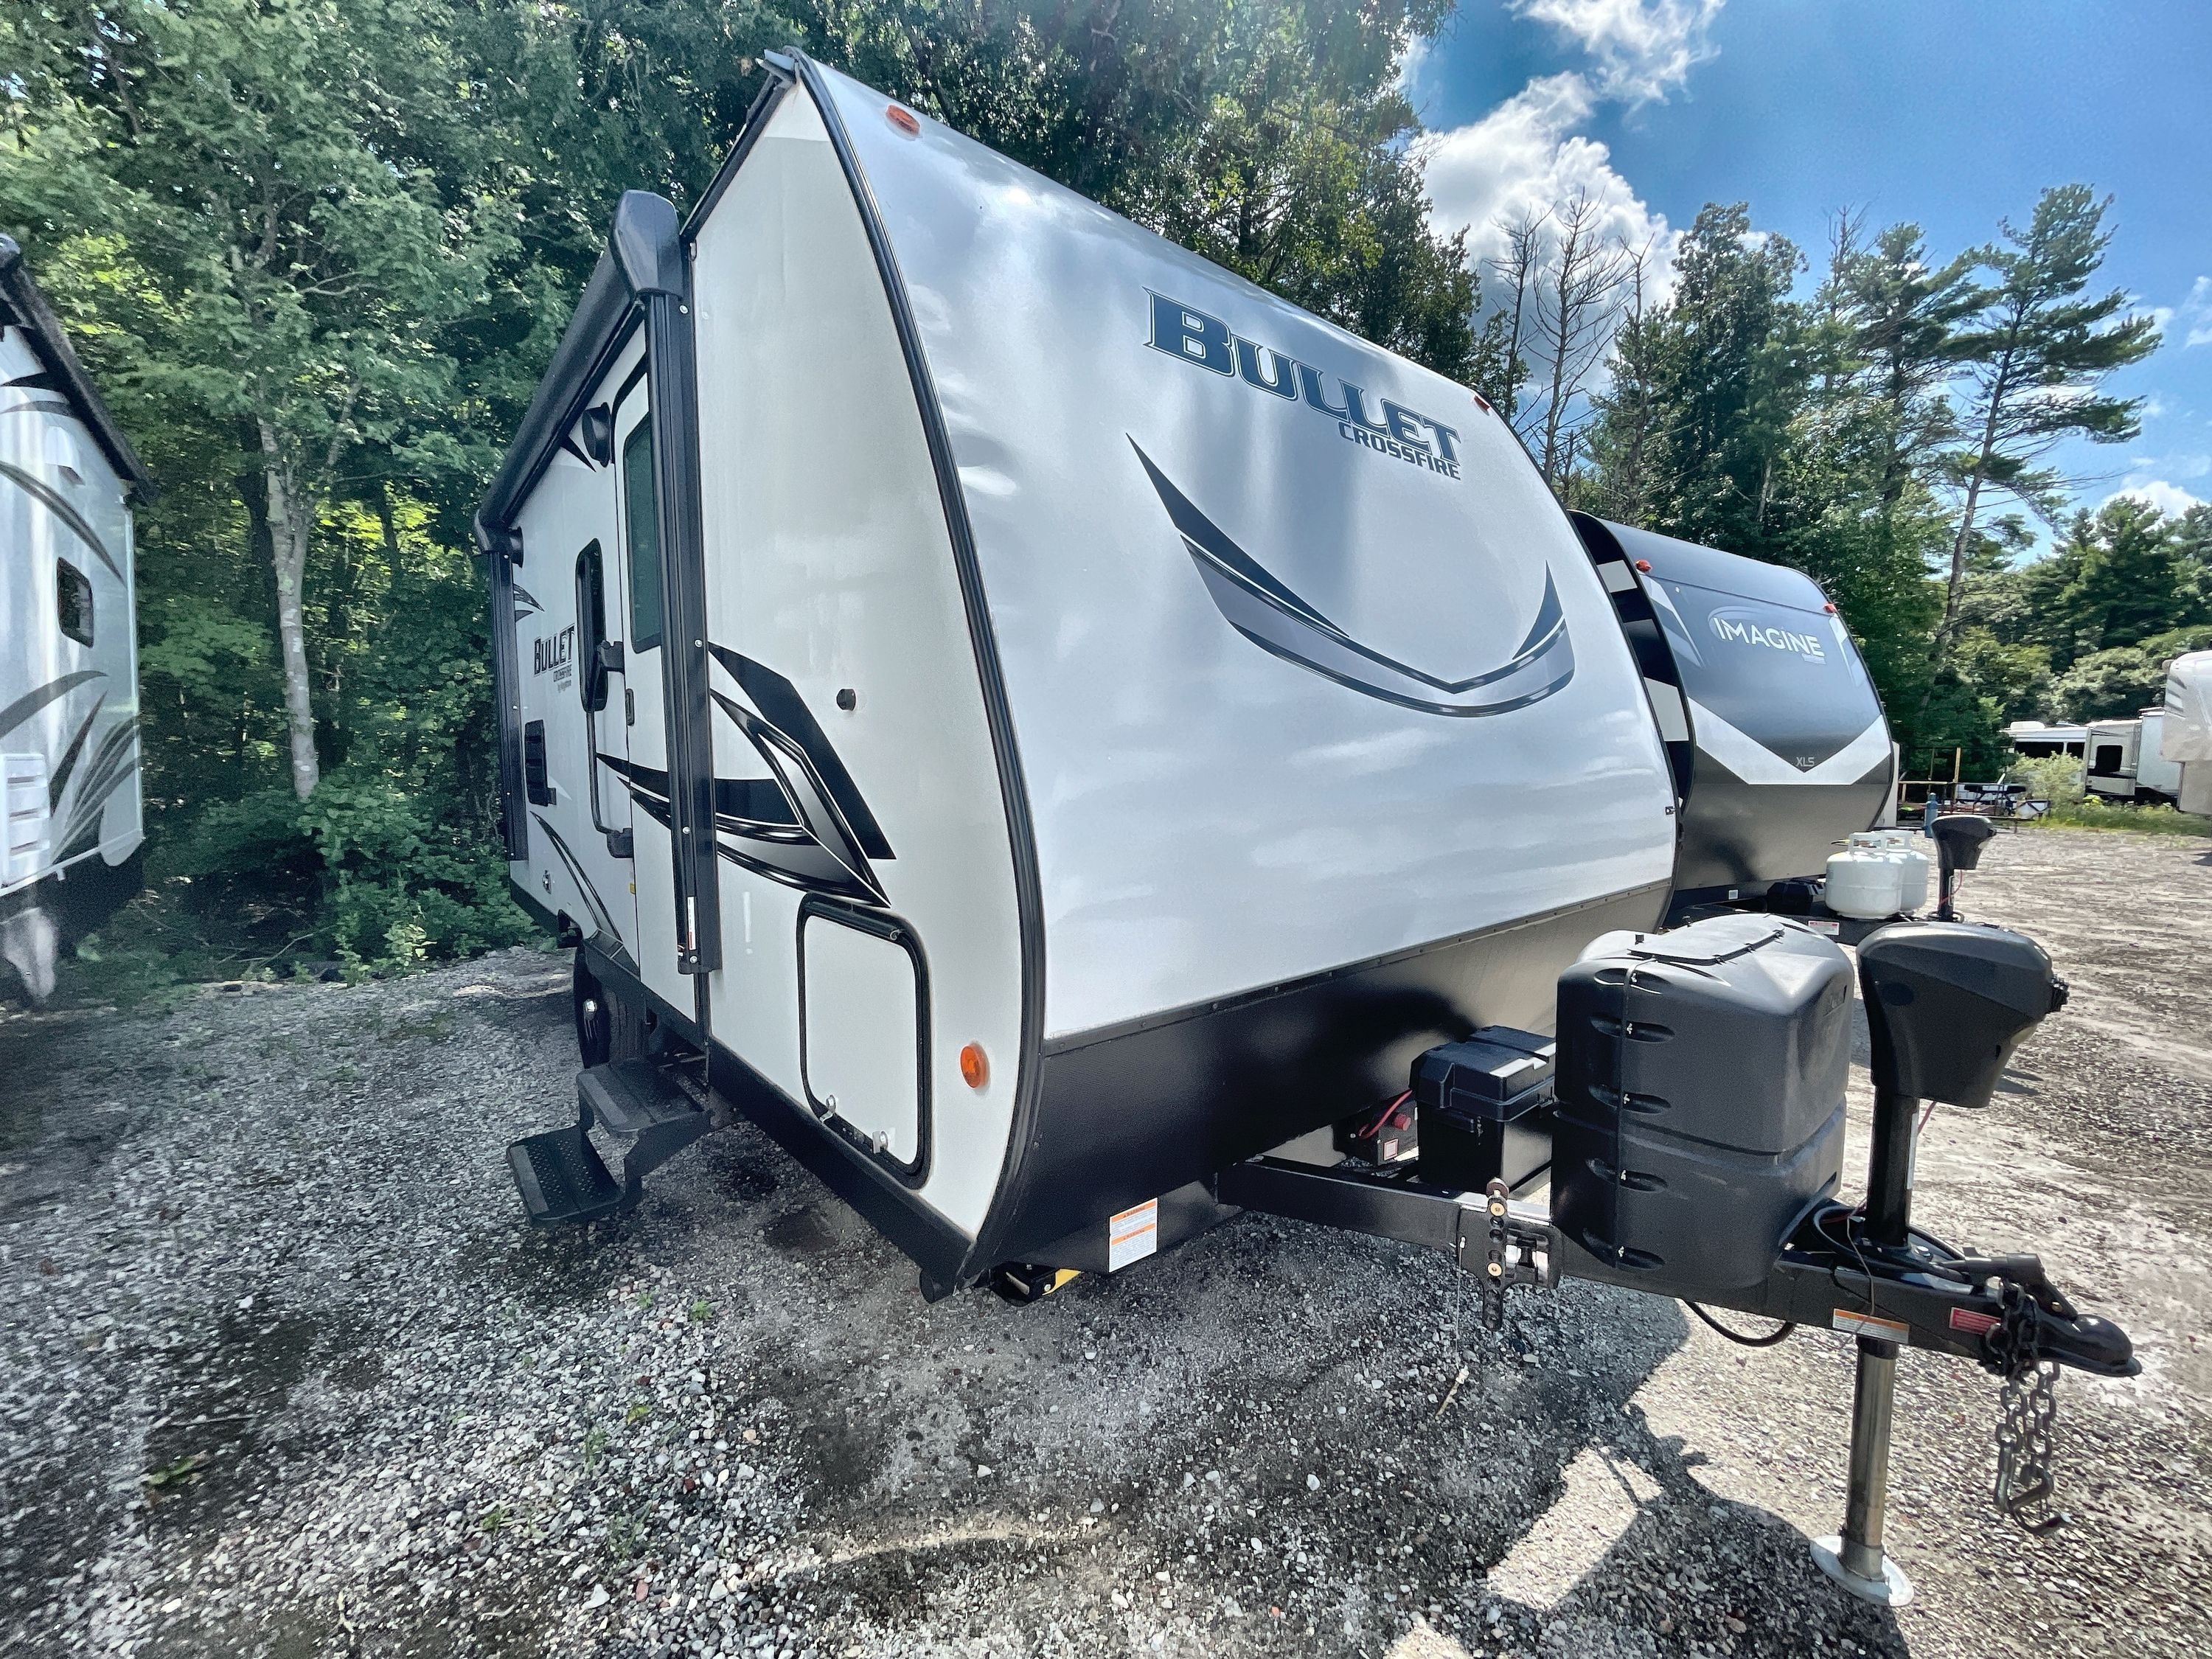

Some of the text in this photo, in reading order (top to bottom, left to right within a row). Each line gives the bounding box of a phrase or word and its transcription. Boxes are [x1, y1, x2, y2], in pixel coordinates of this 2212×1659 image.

[1142, 287, 1461, 465] BULLET
[1338, 422, 1461, 480] CROSSFIRE
[534, 623, 574, 677] BULLET
[1714, 617, 1825, 657] IMAGINE
[1796, 757, 1815, 767] XLS
